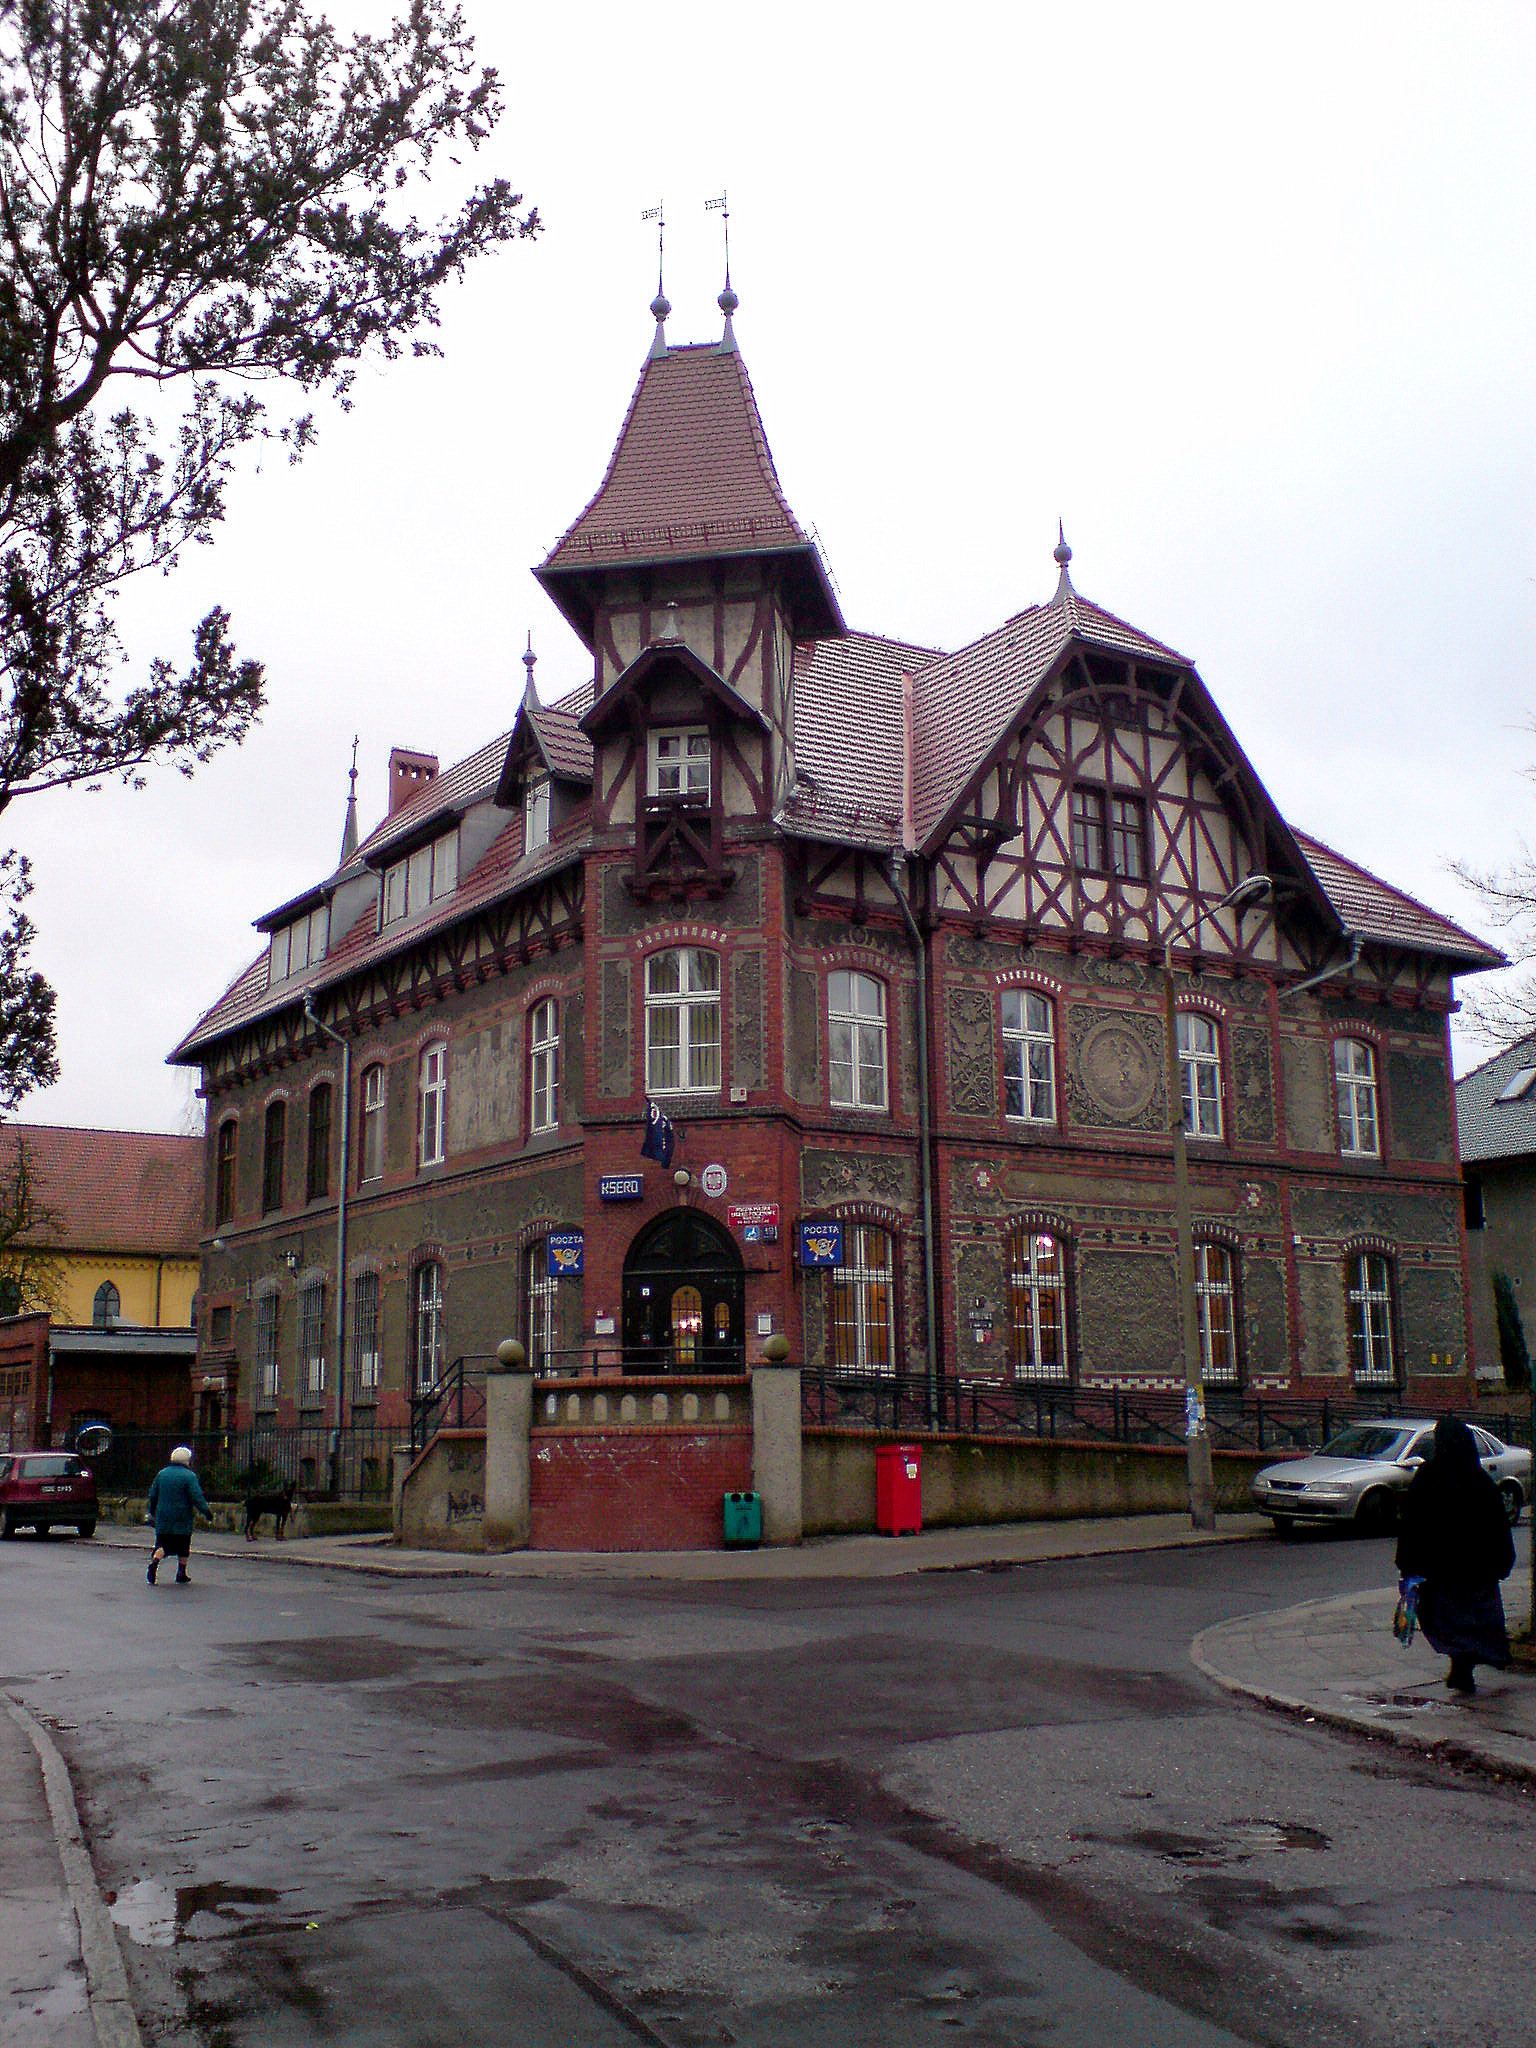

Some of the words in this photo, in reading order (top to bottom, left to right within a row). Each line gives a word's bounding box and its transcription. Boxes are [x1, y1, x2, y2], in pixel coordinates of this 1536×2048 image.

[601, 1181, 638, 1195] KSERO
[804, 1226, 840, 1235] POCZTA
[550, 1235, 584, 1245] POCZTA
